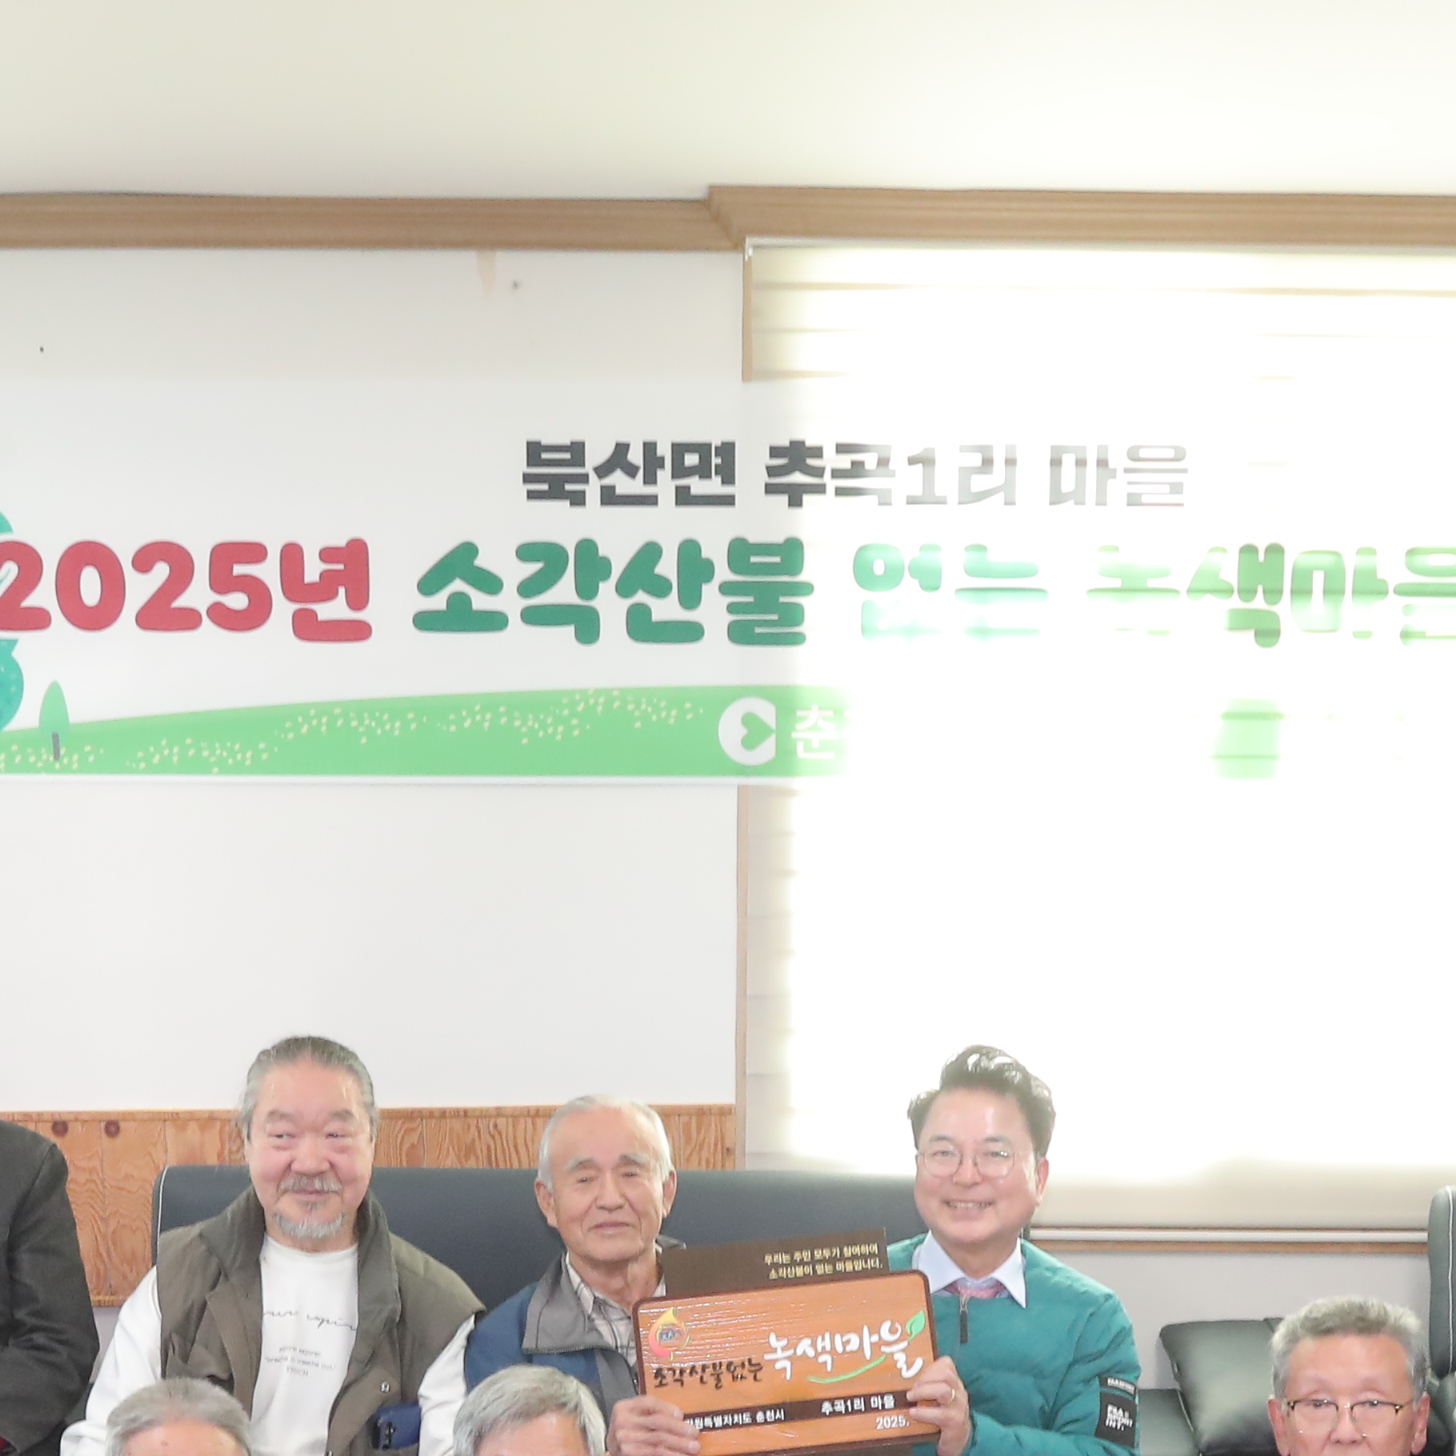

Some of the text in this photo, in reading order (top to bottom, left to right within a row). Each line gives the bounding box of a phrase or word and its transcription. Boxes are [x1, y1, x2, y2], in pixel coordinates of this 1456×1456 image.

[522, 440, 1188, 508] 북산면 추곡1리 마을
[413, 536, 814, 645] 소각산불
[763, 1320, 925, 1381] 녹색마을
[756, 1407, 785, 1423] 춘천시
[821, 1399, 866, 1416] 추곡1리
[870, 1394, 896, 1411] 마을
